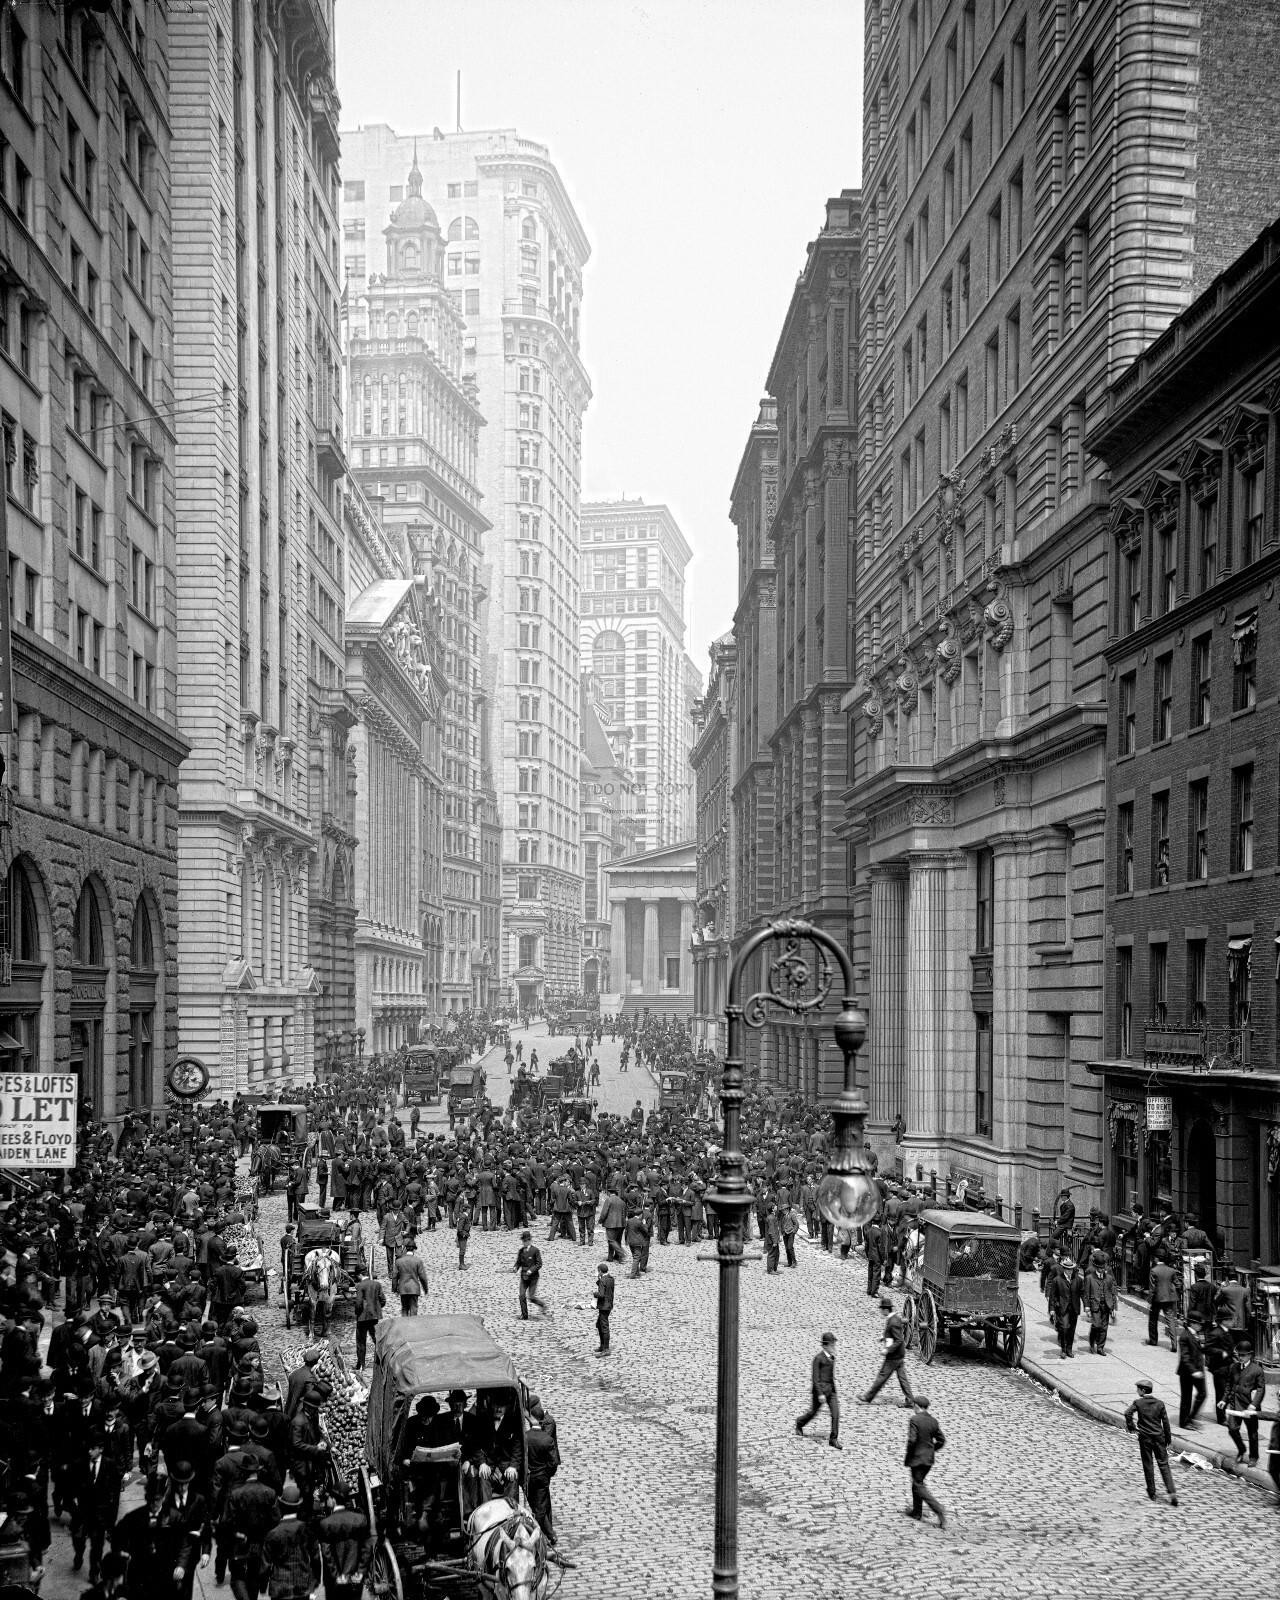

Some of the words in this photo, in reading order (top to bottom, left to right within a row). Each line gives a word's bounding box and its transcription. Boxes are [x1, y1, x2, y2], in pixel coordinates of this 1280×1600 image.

[24, 1076, 32, 1093] &
[34, 1076, 74, 1093] LOFTS
[11, 1097, 73, 1122] LET
[23, 1130, 32, 1145] &
[35, 1131, 72, 1145] FLOYD
[36, 1148, 67, 1159] LANE
